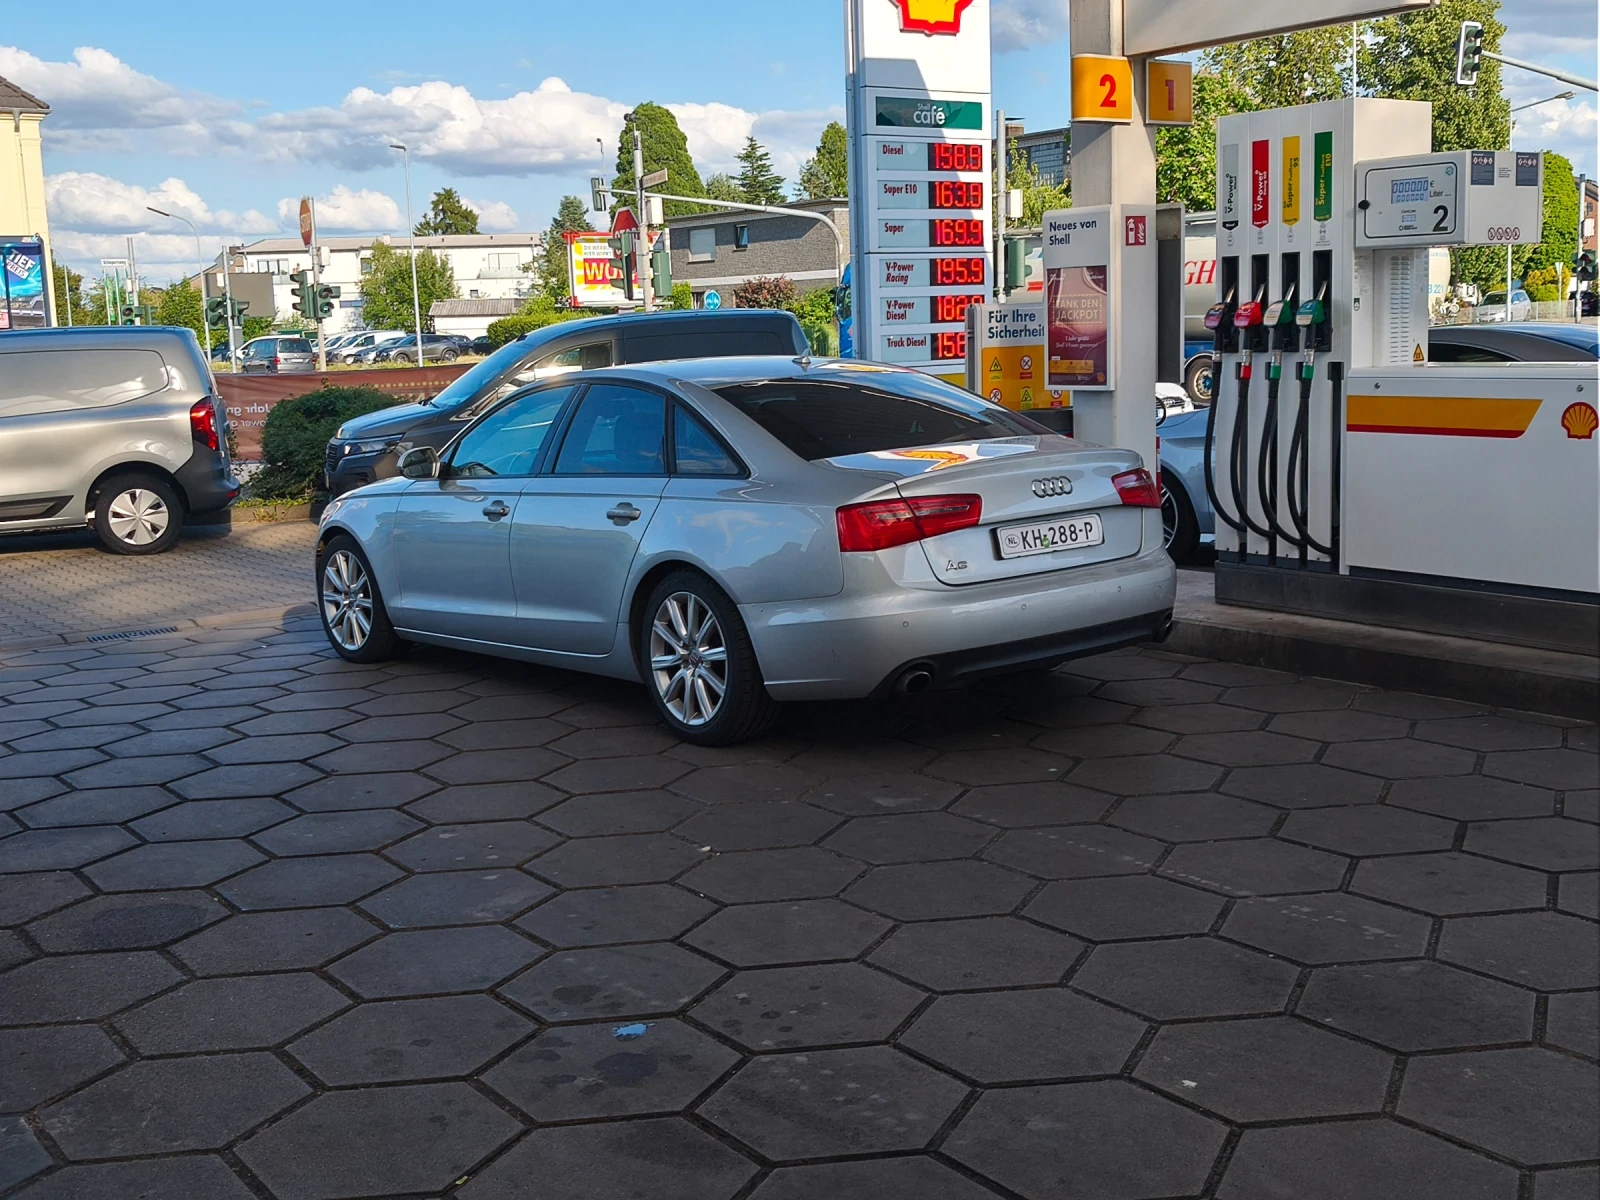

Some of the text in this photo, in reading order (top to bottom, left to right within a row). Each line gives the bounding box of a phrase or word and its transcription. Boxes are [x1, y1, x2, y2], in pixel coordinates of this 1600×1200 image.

[1099, 73, 1117, 108] 2
[1165, 79, 1175, 111] 1
[917, 103, 931, 111] Shell
[913, 105, 946, 125] café
[882, 144, 904, 155] Diesel
[884, 184, 918, 195] Super E10
[1432, 205, 1449, 232] 2
[884, 222, 904, 235] Super
[1049, 220, 1097, 232] Neues von
[1049, 233, 1070, 246] Shell
[9, 248, 36, 271] TIEF
[885, 261, 914, 272] V-Power
[886, 272, 909, 285] Racing
[886, 299, 914, 310] V-Power
[1081, 298, 1099, 308] DEN
[886, 309, 907, 321] Diesel
[988, 308, 1037, 324] Für Ihre
[1056, 309, 1099, 320] JACKPOT
[887, 336, 927, 348] Truck Diesel
[1008, 537, 1018, 545] NL
[1020, 521, 1093, 550] KH-288-P
[945, 559, 968, 572] A6
